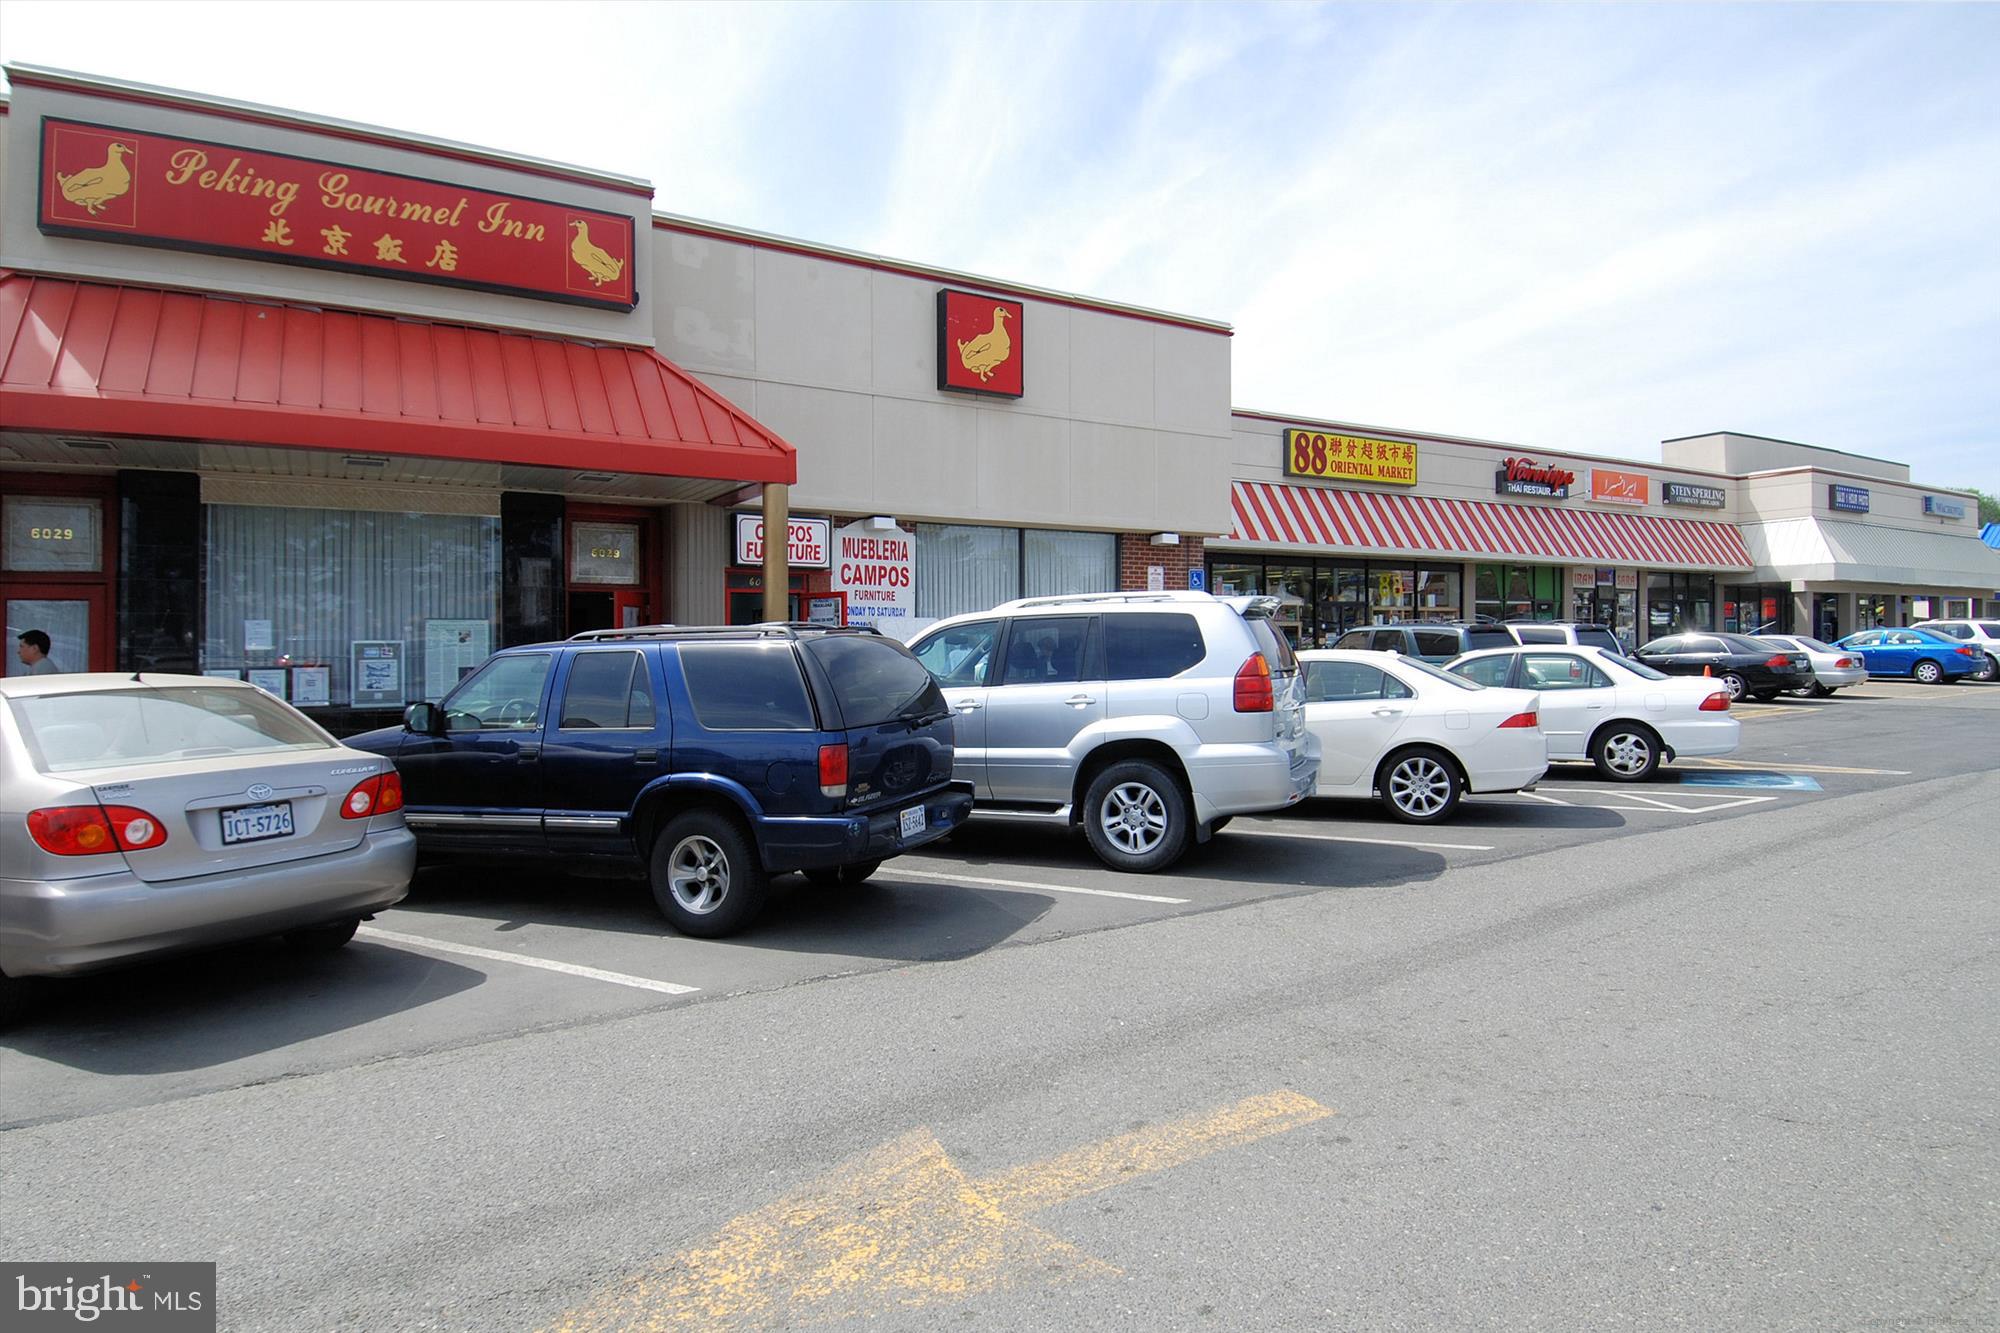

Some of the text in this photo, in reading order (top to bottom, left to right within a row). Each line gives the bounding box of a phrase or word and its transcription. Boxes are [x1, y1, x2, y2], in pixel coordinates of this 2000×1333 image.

[165, 148, 545, 242] Peking Gourmet Inn
[261, 218, 459, 272] 北京飯店
[1294, 432, 1328, 475] 88
[1330, 460, 1413, 480] ORIENTAL MARKET
[1507, 482, 1523, 493] THAI
[1671, 485, 1724, 501] STEIN SPERLING
[31, 528, 73, 541] 6029
[755, 523, 813, 542] CPOS
[746, 541, 821, 560] FUTURE
[842, 537, 909, 561] MUEBLERIA
[840, 563, 910, 587] CAMPOS
[1574, 572, 1594, 585] IRAN
[854, 590, 896, 601] FURNITURE
[847, 606, 906, 617] ONDAY TO SATURDAY
[227, 812, 290, 837] JCT-5726
